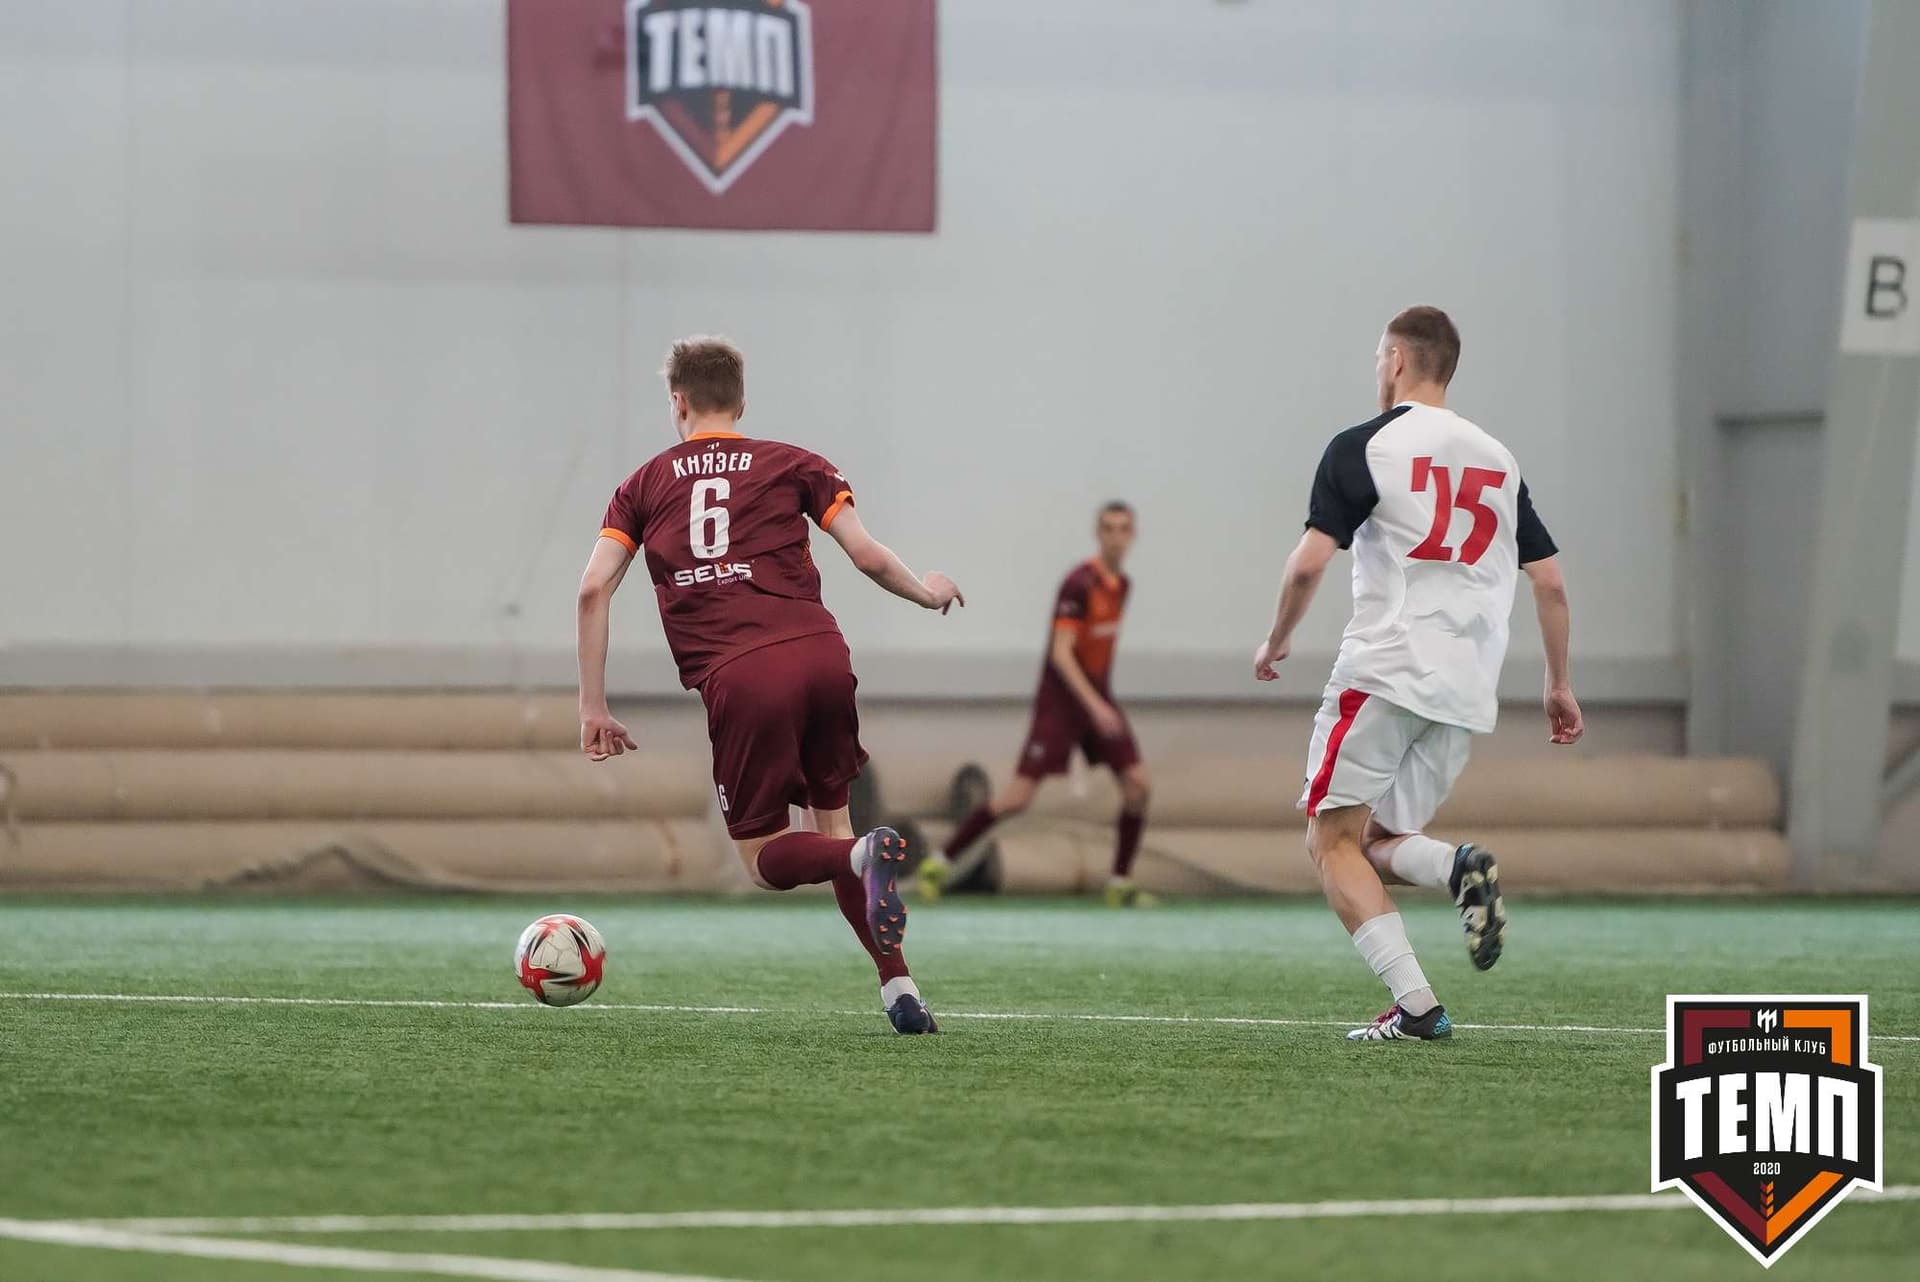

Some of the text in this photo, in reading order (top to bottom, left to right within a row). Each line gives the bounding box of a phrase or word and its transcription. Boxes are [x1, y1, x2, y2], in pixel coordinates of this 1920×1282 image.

[644, 7, 794, 97] ТЕМП
[672, 452, 753, 480] КНЯЗЕВ
[689, 477, 731, 559] 6
[1406, 456, 1508, 566] 25
[718, 784, 729, 812] 6
